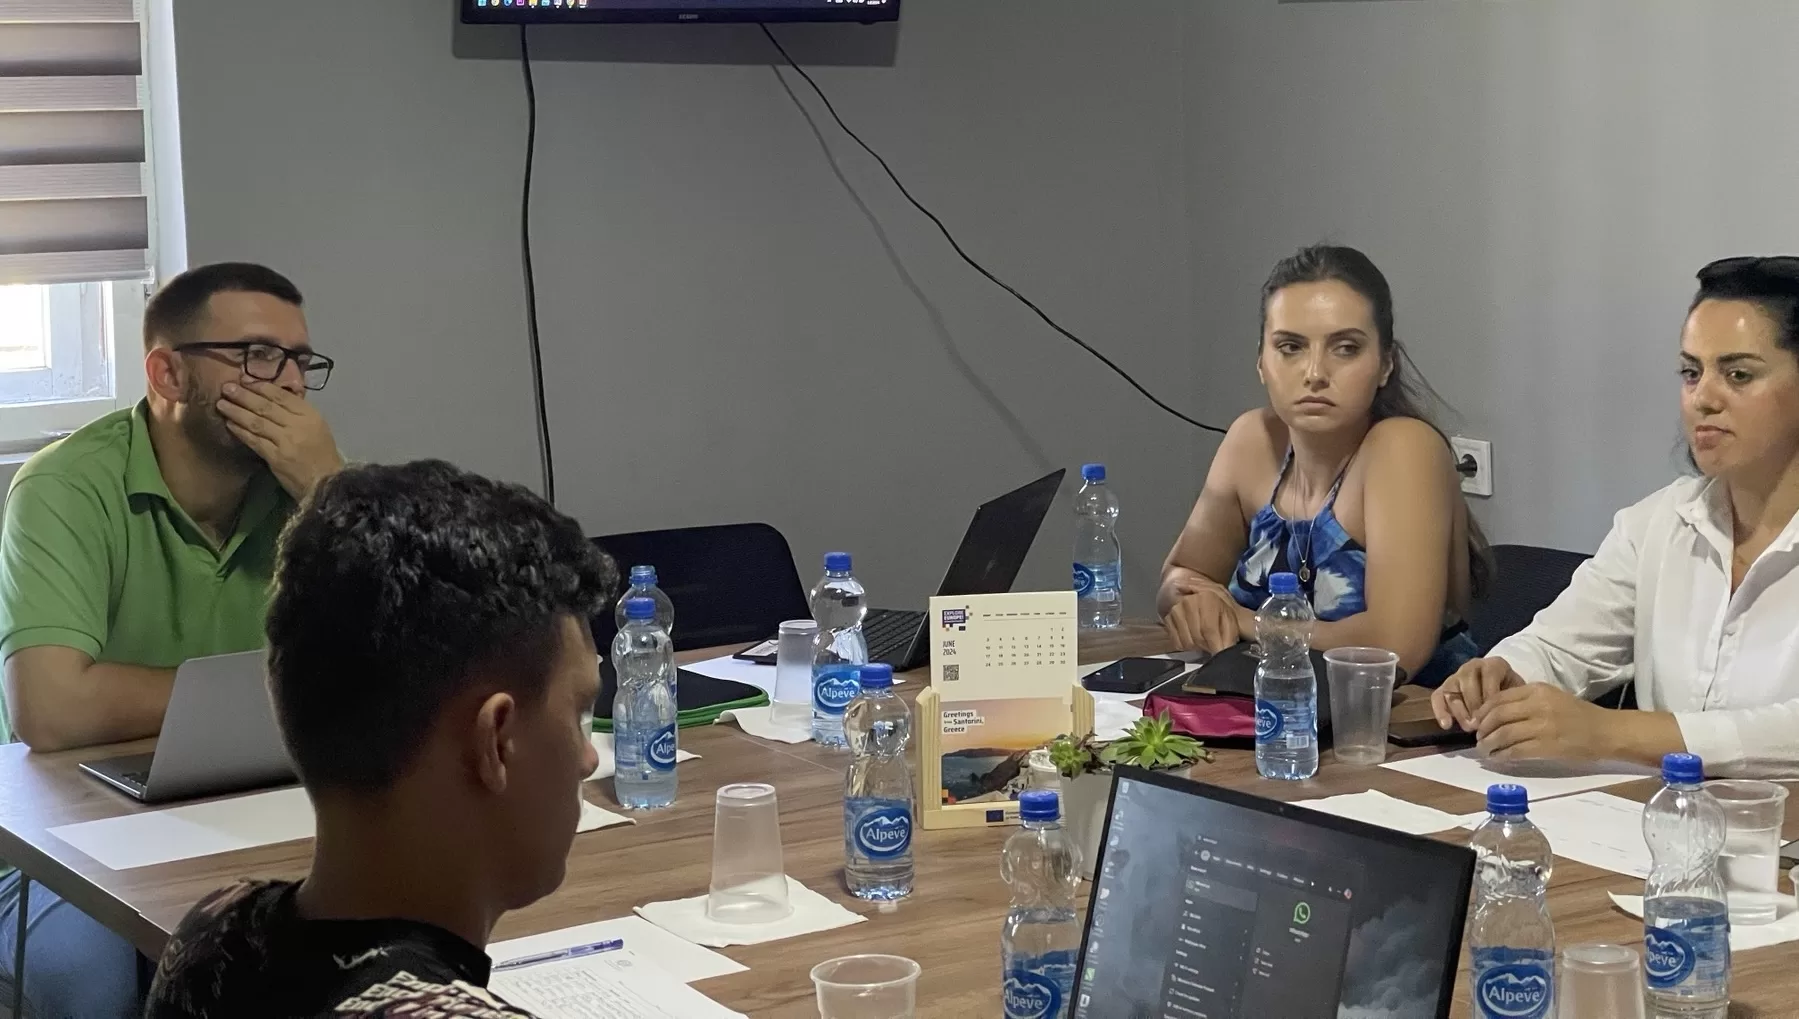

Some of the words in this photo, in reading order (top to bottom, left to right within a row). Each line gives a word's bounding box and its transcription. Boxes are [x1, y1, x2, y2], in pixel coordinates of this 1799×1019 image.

[943, 640, 955, 648] JUNE
[943, 648, 956, 656] 2024
[821, 687, 855, 699] Alpeve
[953, 717, 984, 725] Santorini,
[656, 743, 675, 756] Alpe
[866, 827, 906, 843] Alpeve
[1648, 951, 1677, 968] peve
[1488, 985, 1540, 1005] Alpeve
